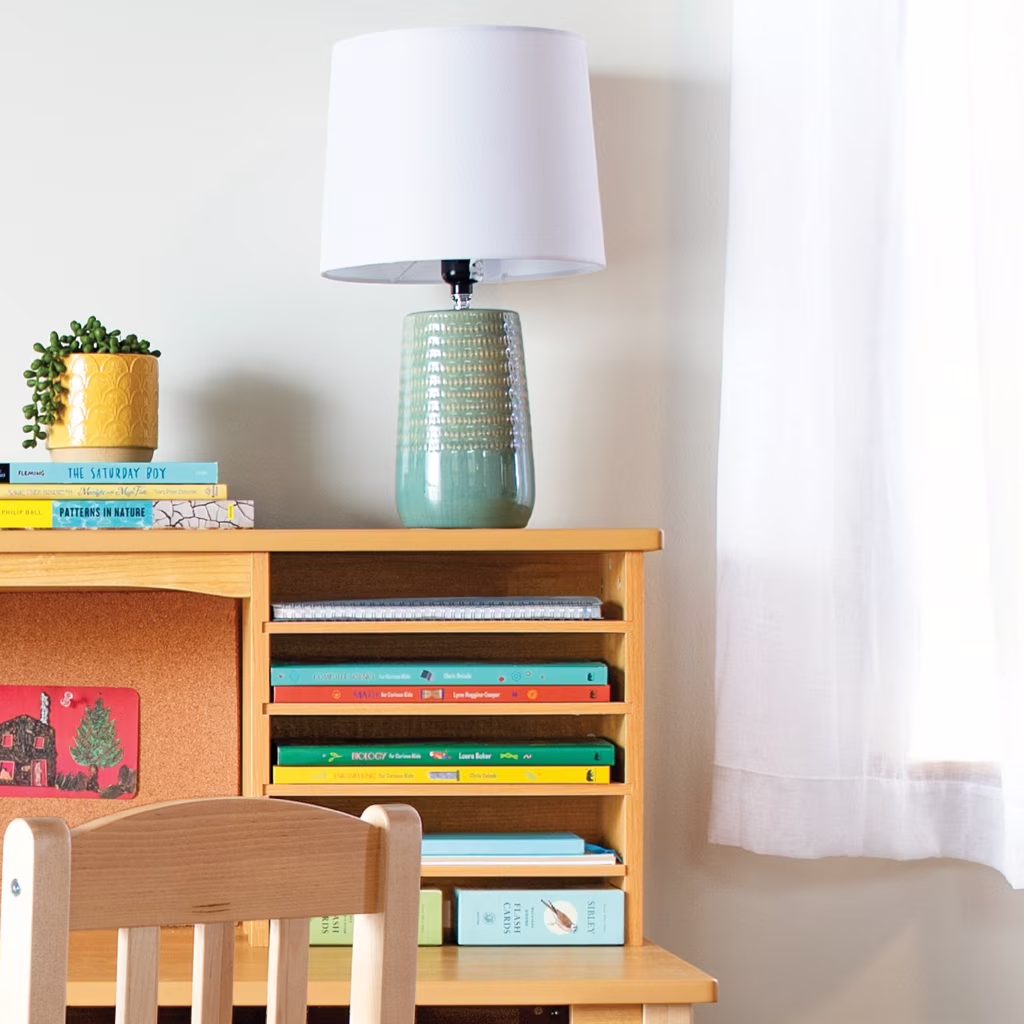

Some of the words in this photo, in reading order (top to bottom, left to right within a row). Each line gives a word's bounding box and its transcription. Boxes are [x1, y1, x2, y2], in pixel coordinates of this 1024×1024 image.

[17, 469, 45, 477] FLEMING
[68, 467, 84, 480] THE
[90, 466, 140, 480] SATURDAY
[146, 466, 167, 480] BOY
[59, 507, 101, 518] PATTERNS
[103, 507, 112, 518] IN
[114, 507, 146, 518] NATURE
[351, 751, 387, 761] BIOLOGY
[411, 752, 422, 760] Kids
[458, 752, 475, 760] Laura
[503, 902, 512, 935] CARDS
[513, 903, 522, 934] FLASH
[586, 900, 596, 936] SIBLEY
